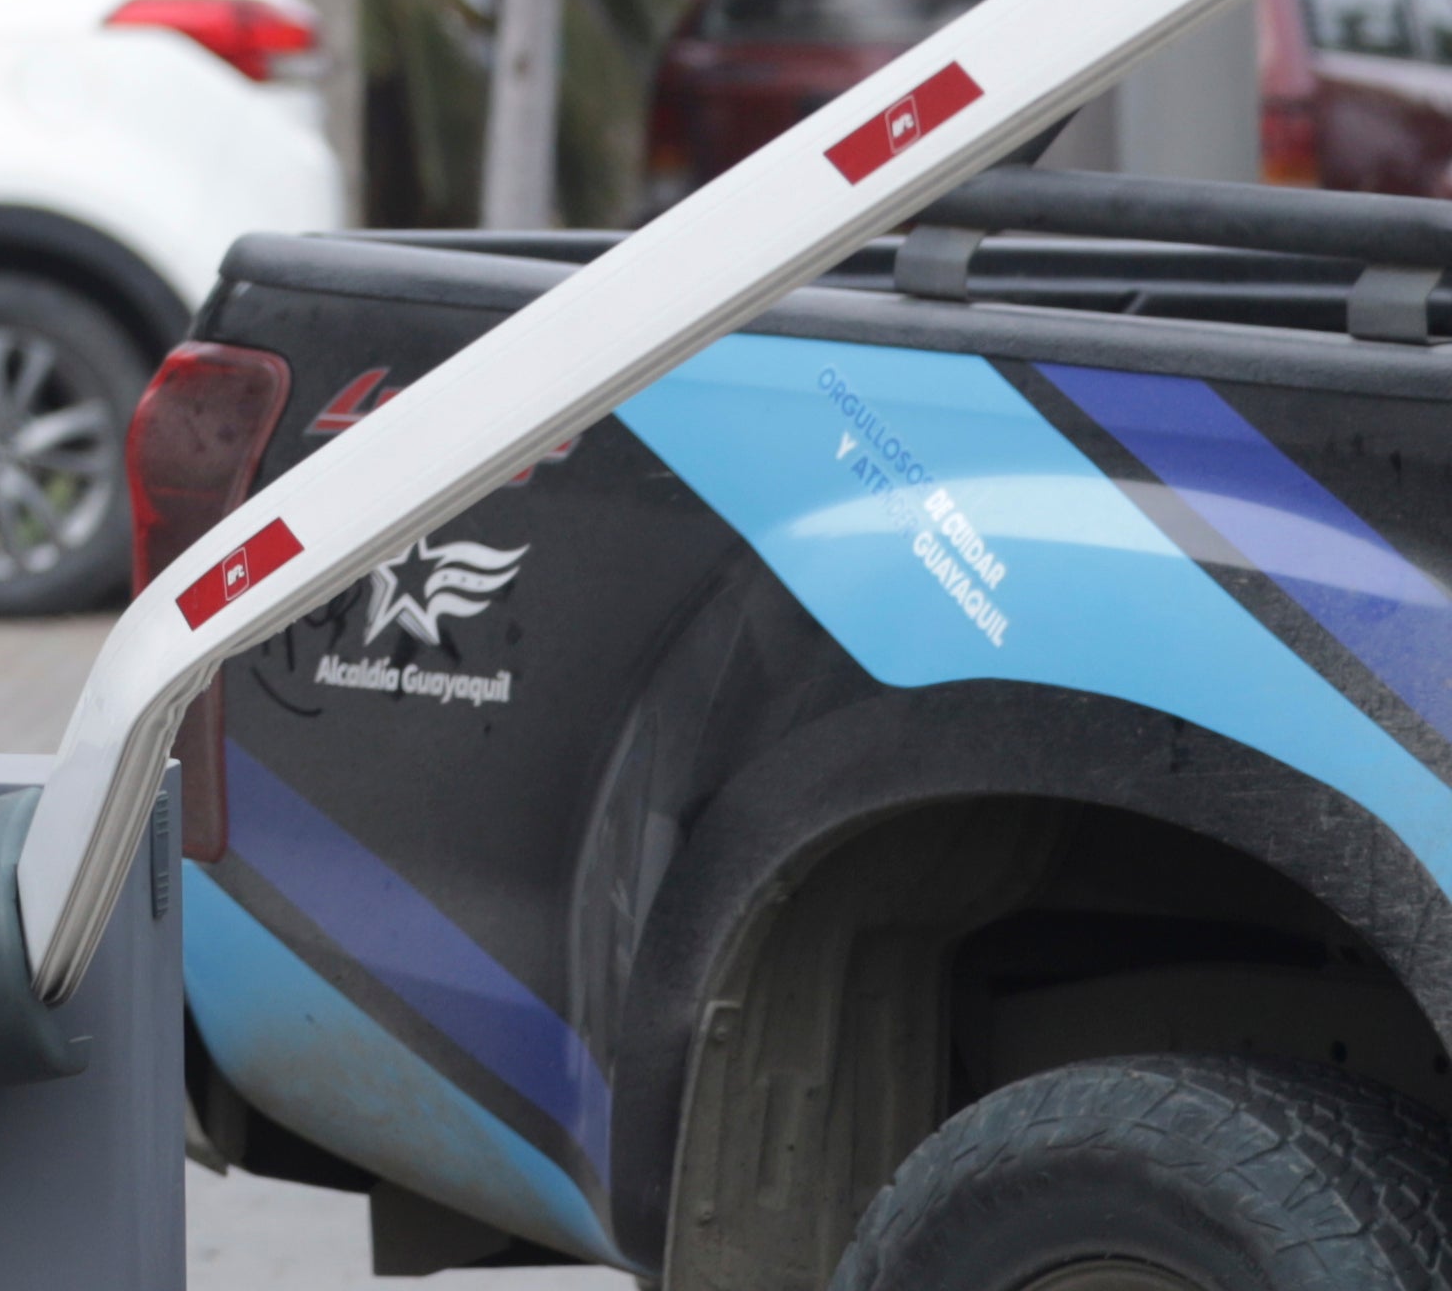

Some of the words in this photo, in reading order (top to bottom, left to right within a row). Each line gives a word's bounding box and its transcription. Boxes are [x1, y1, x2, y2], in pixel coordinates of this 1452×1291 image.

[834, 430, 858, 461] Y
[912, 530, 1010, 649] GUAYAQUIL
[923, 487, 956, 522] DE
[940, 511, 1008, 591] CUIDAR
[313, 653, 400, 692] Alcaldía
[400, 663, 512, 707] Guayaquil
